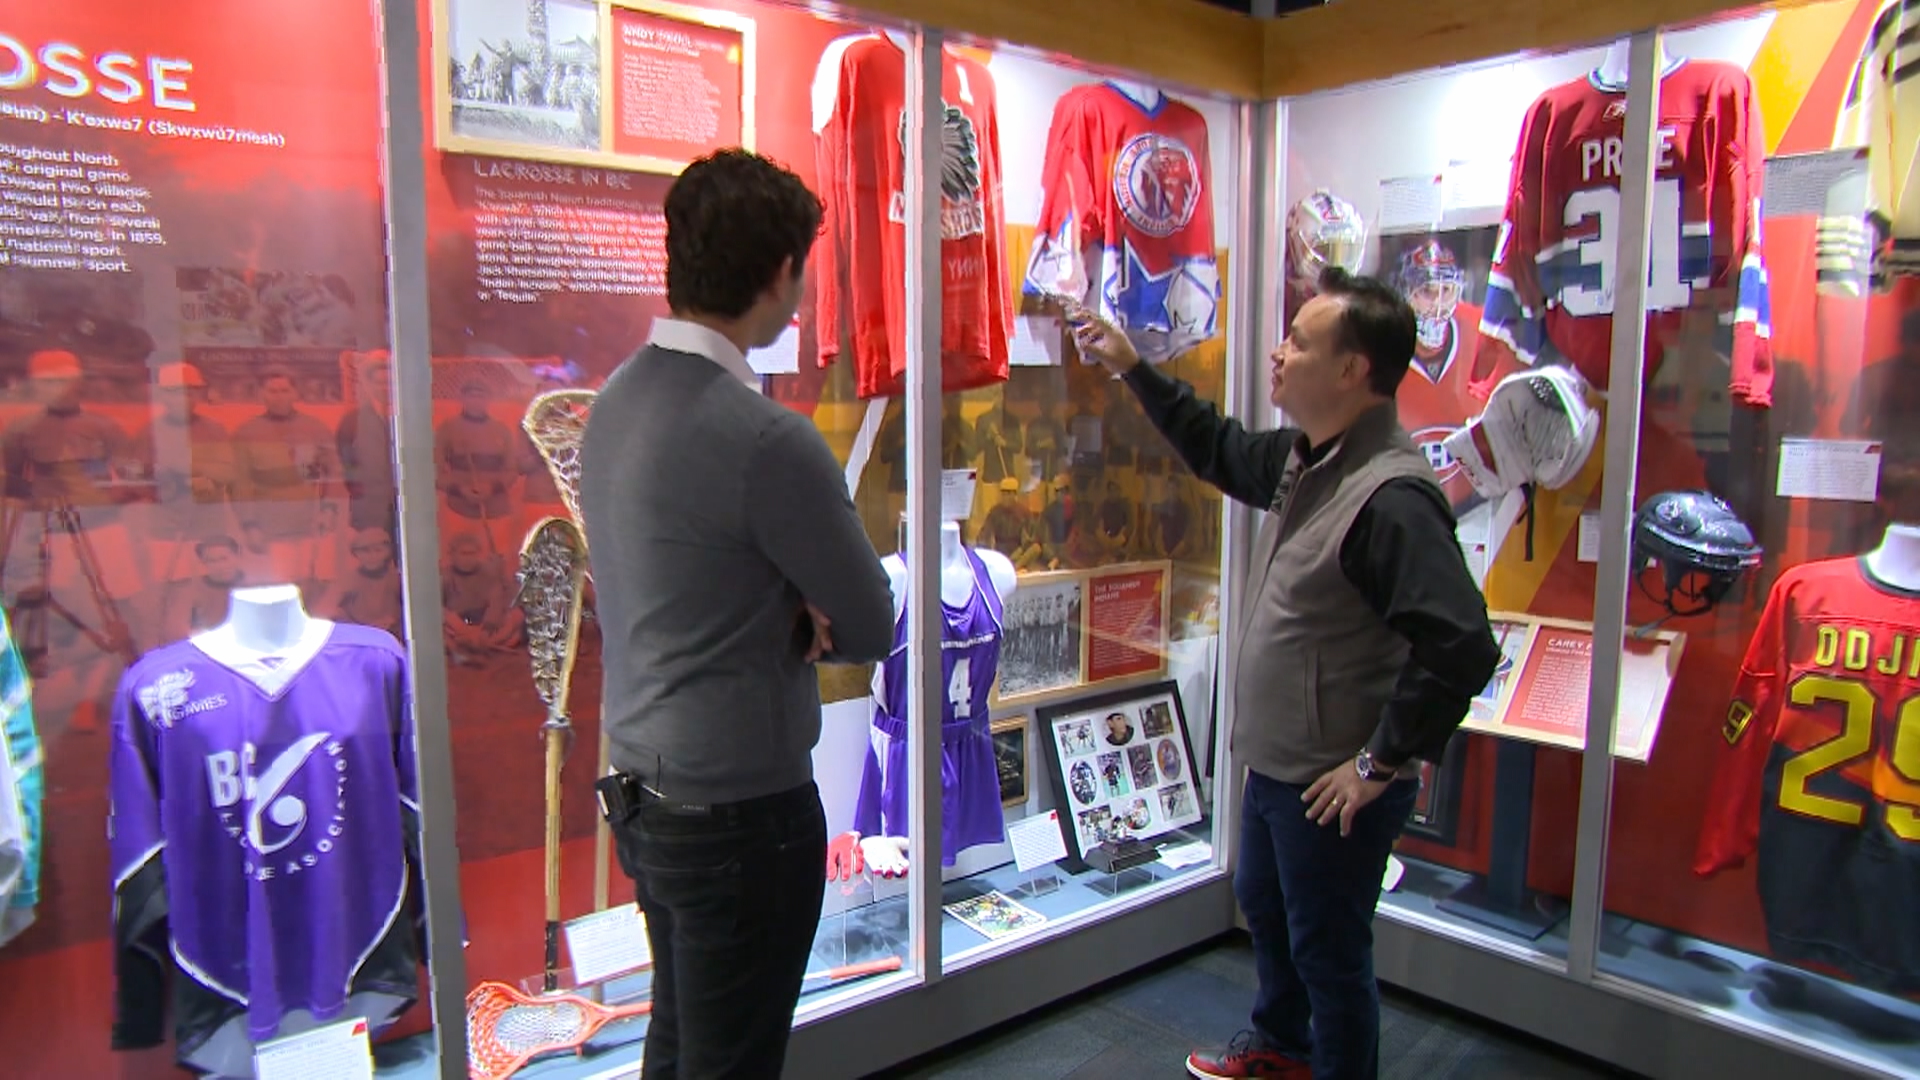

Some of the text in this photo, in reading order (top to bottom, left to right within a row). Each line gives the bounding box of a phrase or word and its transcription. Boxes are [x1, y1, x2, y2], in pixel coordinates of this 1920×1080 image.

[23, 162, 83, 181] original
[73, 151, 120, 167] North
[474, 159, 576, 186] LACROSSE
[582, 171, 600, 187] IN
[1582, 127, 1677, 182] PRE
[109, 200, 146, 213] each
[1561, 178, 1692, 317] 31
[948, 657, 973, 720] 4
[206, 741, 257, 808] BC
